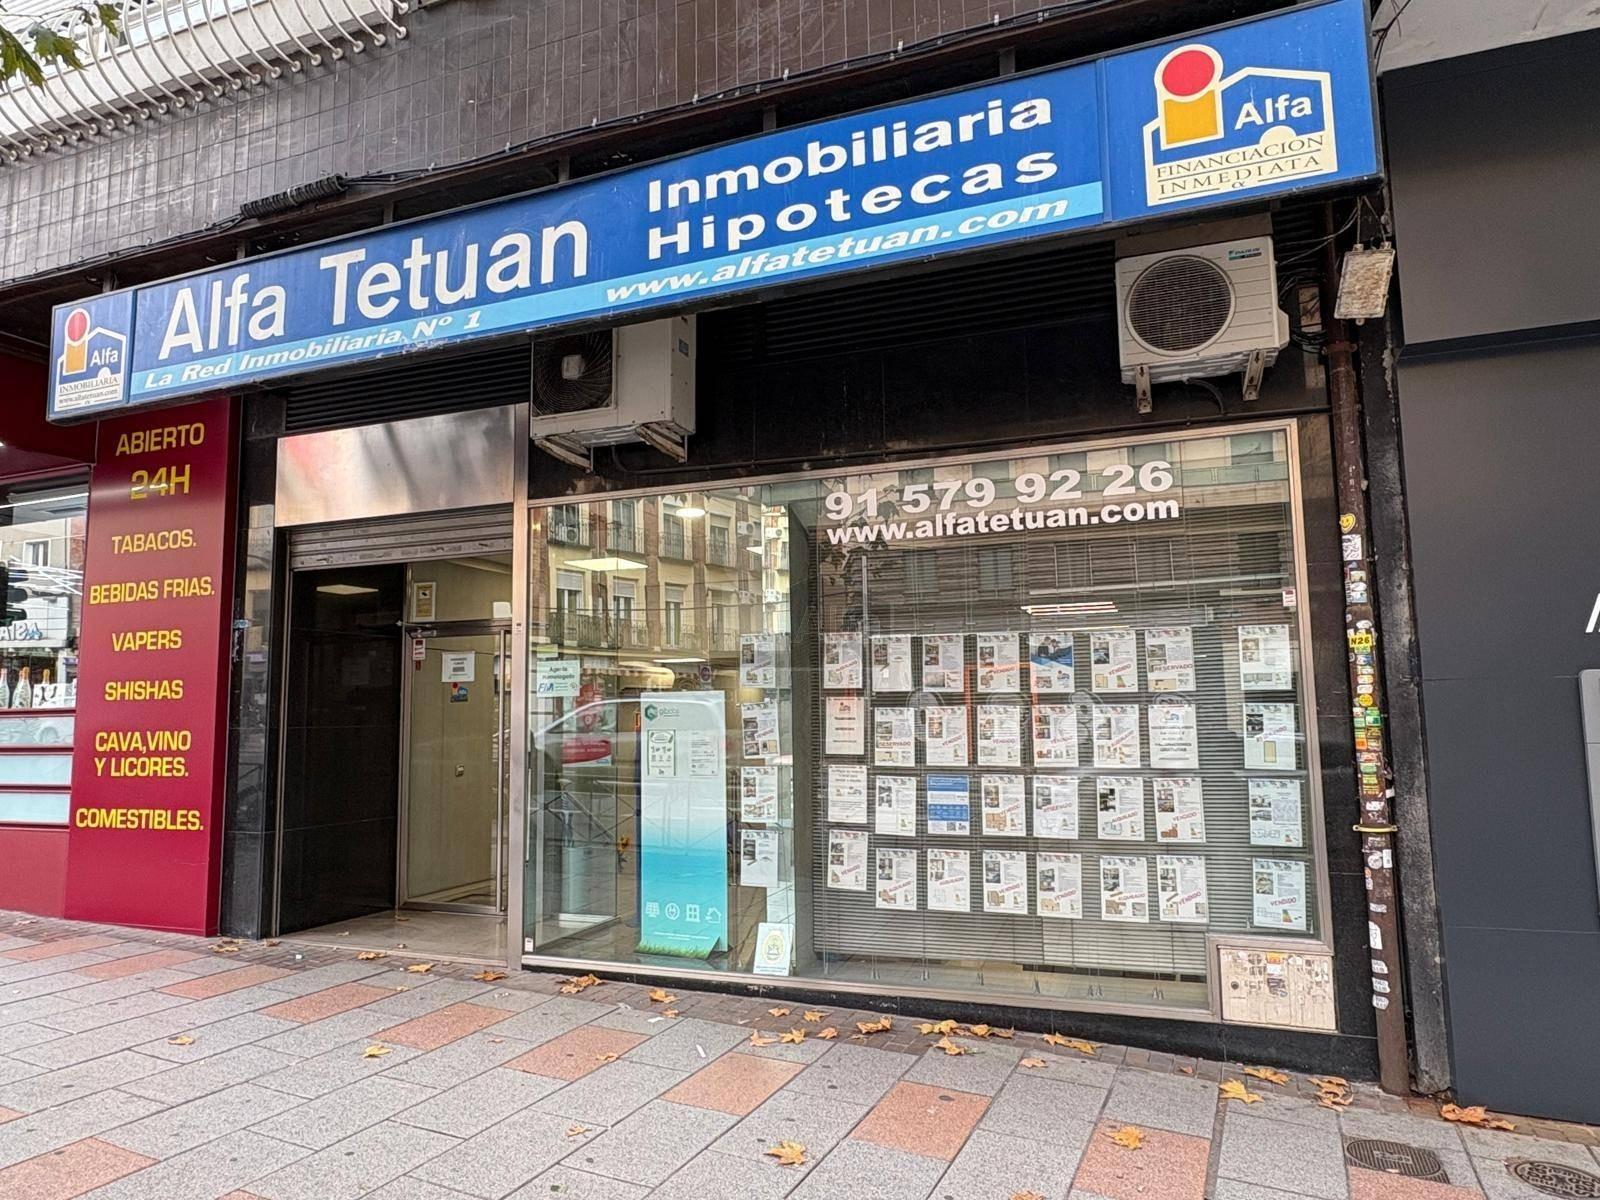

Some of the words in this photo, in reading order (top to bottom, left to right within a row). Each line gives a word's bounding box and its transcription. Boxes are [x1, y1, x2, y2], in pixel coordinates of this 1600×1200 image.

[1234, 93, 1313, 131] Alfa
[648, 96, 1053, 213] Inmobiliaria
[1159, 155, 1321, 195] INMEDIATA
[648, 150, 1059, 261] Hipotecas
[605, 198, 1069, 304] www.alfatetuan.com
[158, 272, 287, 361] Alfa
[319, 219, 589, 326] Tetuan
[89, 347, 119, 367] Alfa
[143, 372, 172, 388] La
[181, 358, 232, 382] Red
[463, 310, 482, 330] 1
[59, 376, 119, 394] INMOBILIARIA
[116, 422, 205, 456] ABIERTO
[131, 464, 191, 500] 24H
[825, 488, 878, 520] 91
[902, 477, 996, 514] 579
[1014, 469, 1082, 503] 92
[1102, 461, 1174, 497] 26
[826, 498, 1180, 545] www.alfatetuan.com
[111, 528, 197, 554] TABACOS.
[89, 580, 159, 604] BEBIDAS
[163, 576, 215, 598] FRIAS.
[112, 629, 182, 652] VAPERS
[1351, 637, 1370, 645] N26
[1154, 664, 1193, 672] RESERVADO
[104, 679, 184, 701] SHISHAS
[94, 757, 106, 777] Y
[110, 757, 189, 777] LICORES.
[75, 807, 204, 830] COMESTIBLES.
[1270, 897, 1297, 907] VENDIDO
